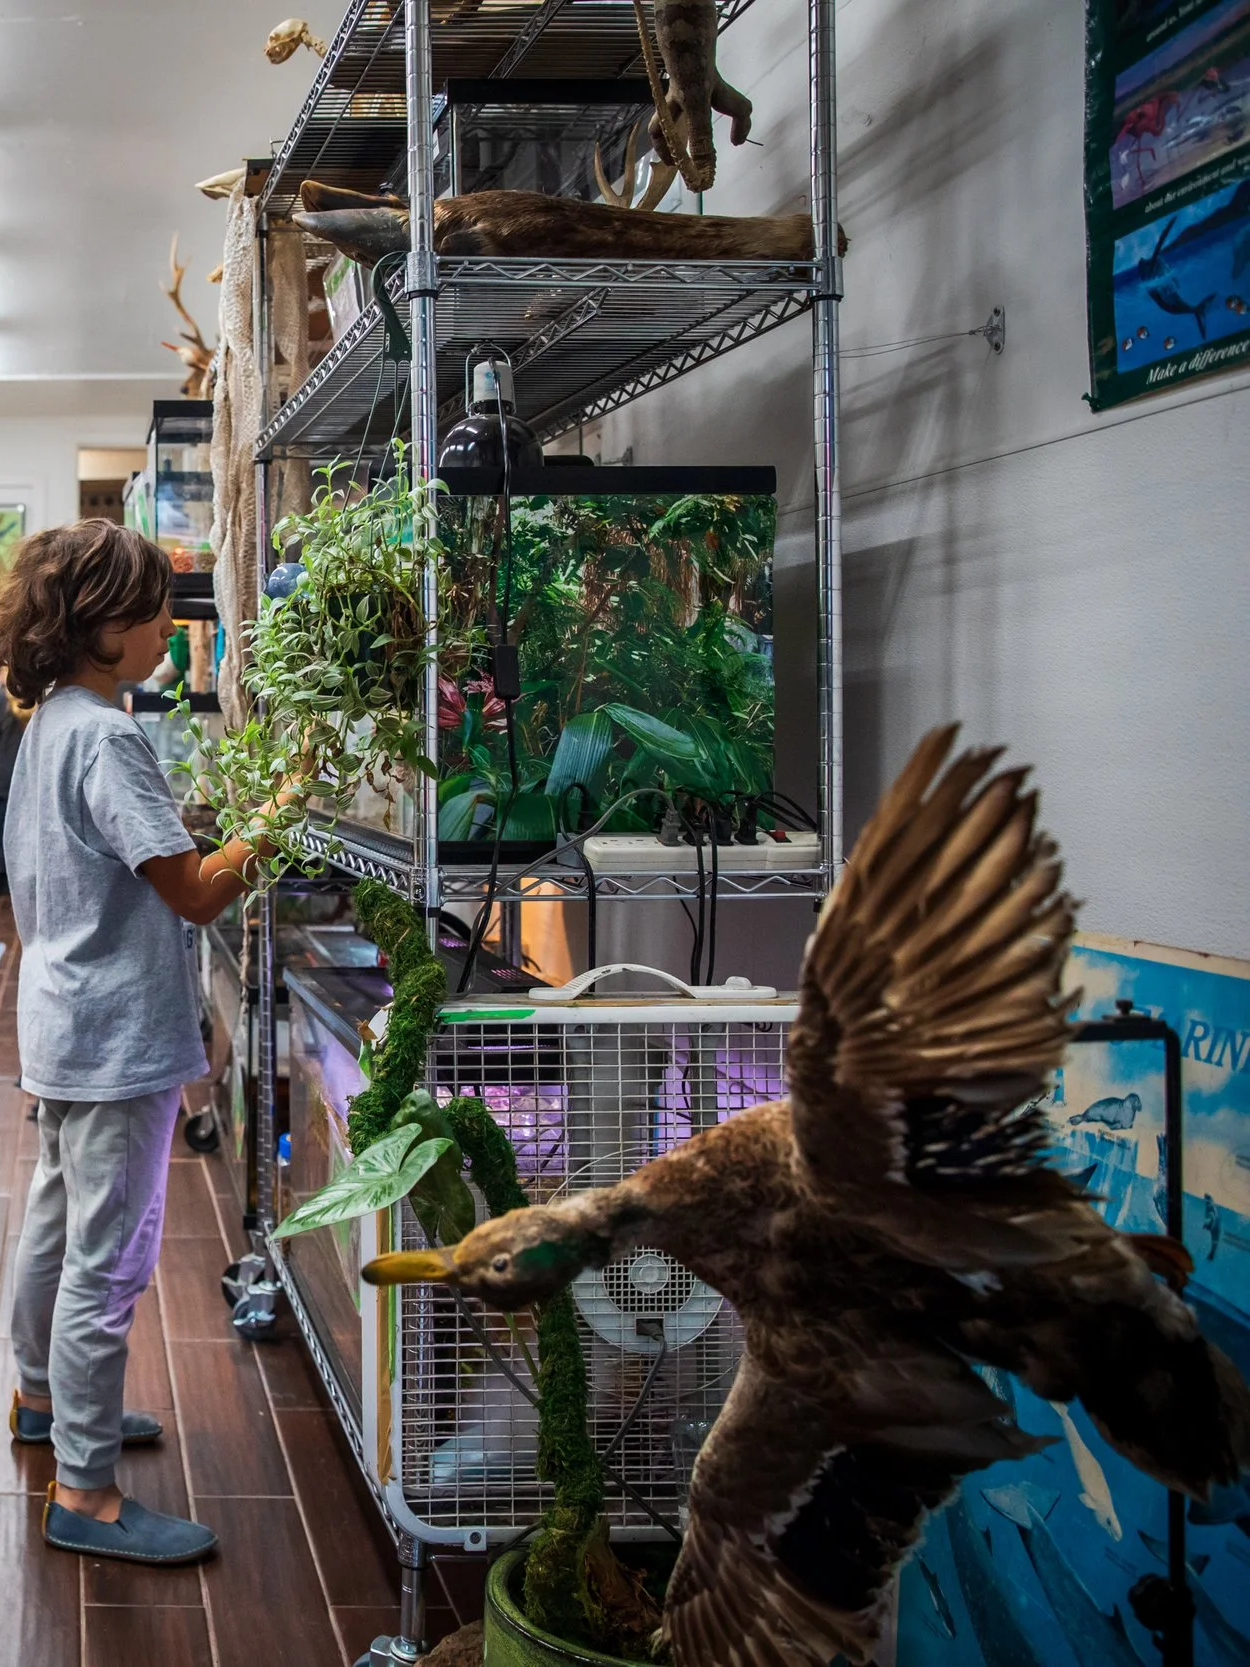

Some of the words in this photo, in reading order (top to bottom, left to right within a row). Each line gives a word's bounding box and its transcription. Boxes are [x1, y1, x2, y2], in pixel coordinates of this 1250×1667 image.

[1146, 363, 1178, 385] Make
[1178, 361, 1188, 373] a
[1188, 339, 1250, 372] difference
